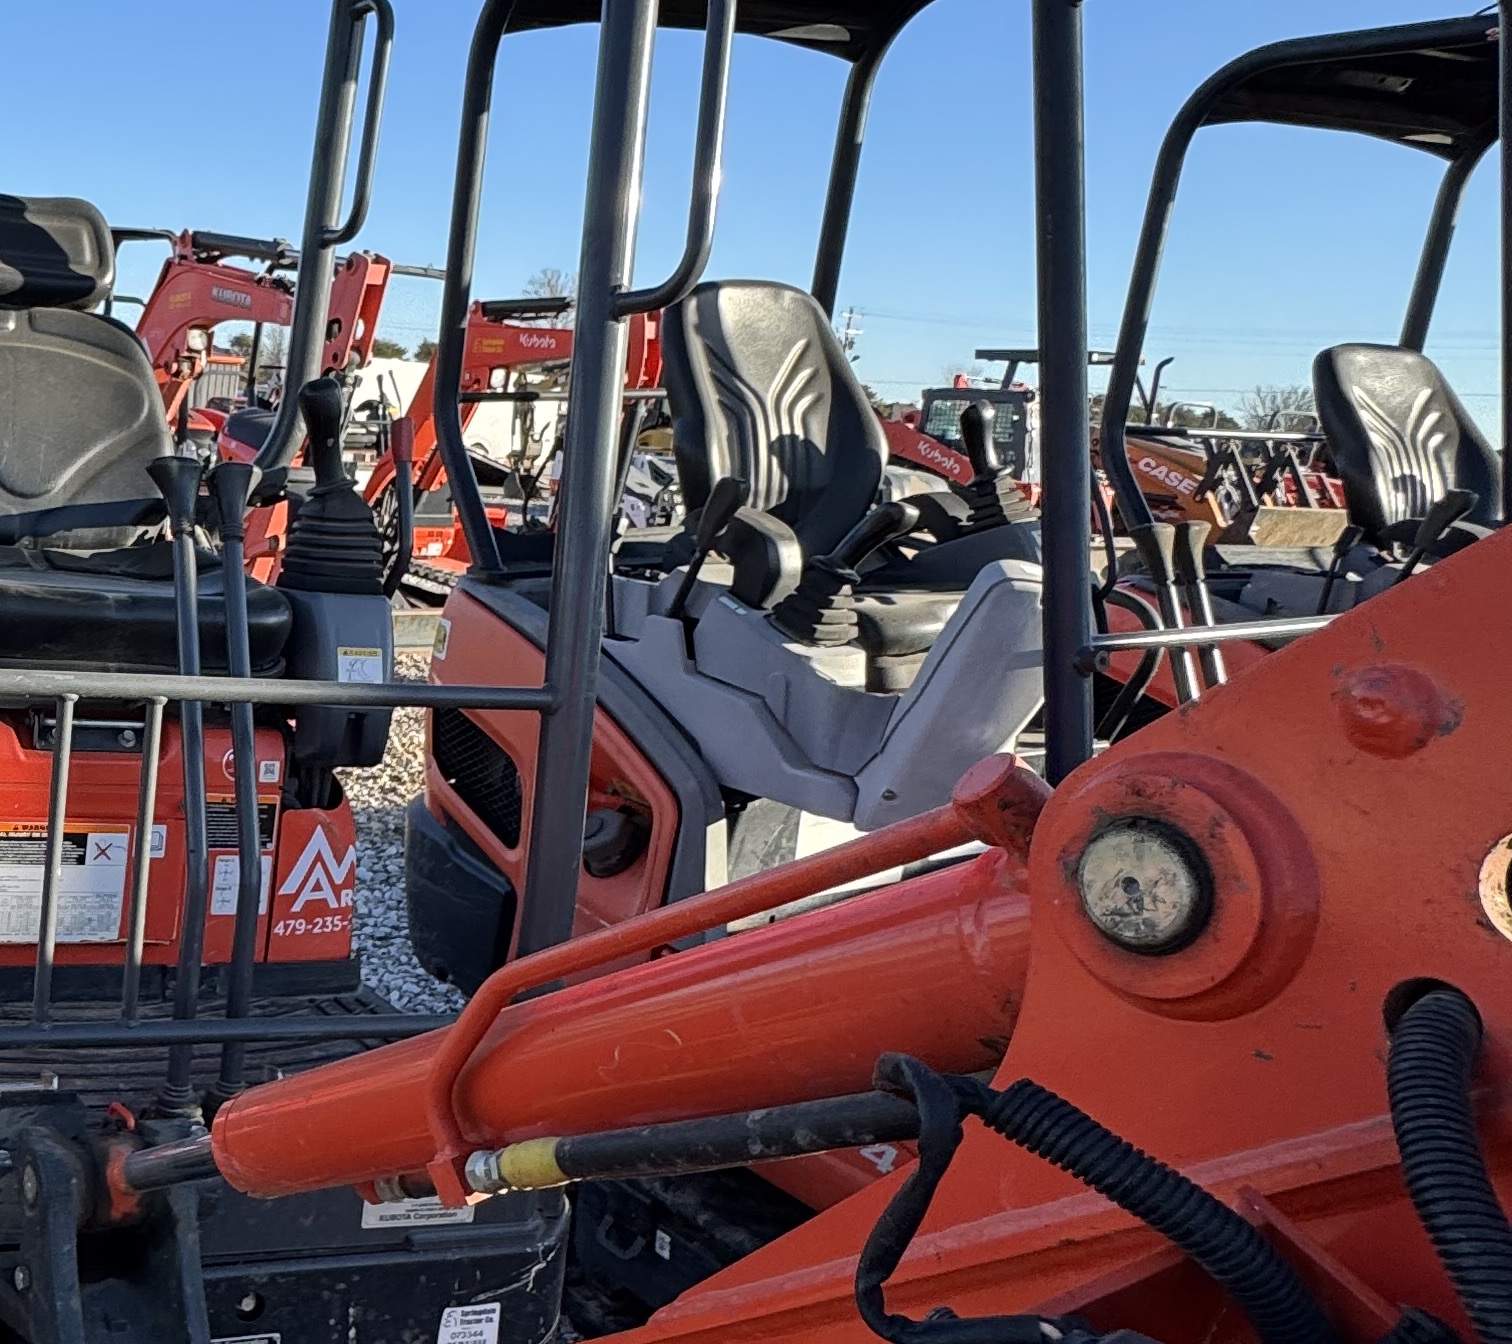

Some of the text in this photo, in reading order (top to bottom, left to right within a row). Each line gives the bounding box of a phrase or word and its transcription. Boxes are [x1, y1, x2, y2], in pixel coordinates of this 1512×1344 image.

[519, 333, 556, 349] Kubota
[917, 440, 961, 475] Kubota
[1138, 457, 1200, 495] CASE
[274, 915, 352, 937] 479-235-
[378, 1212, 458, 1222] KUBOTA Corporation
